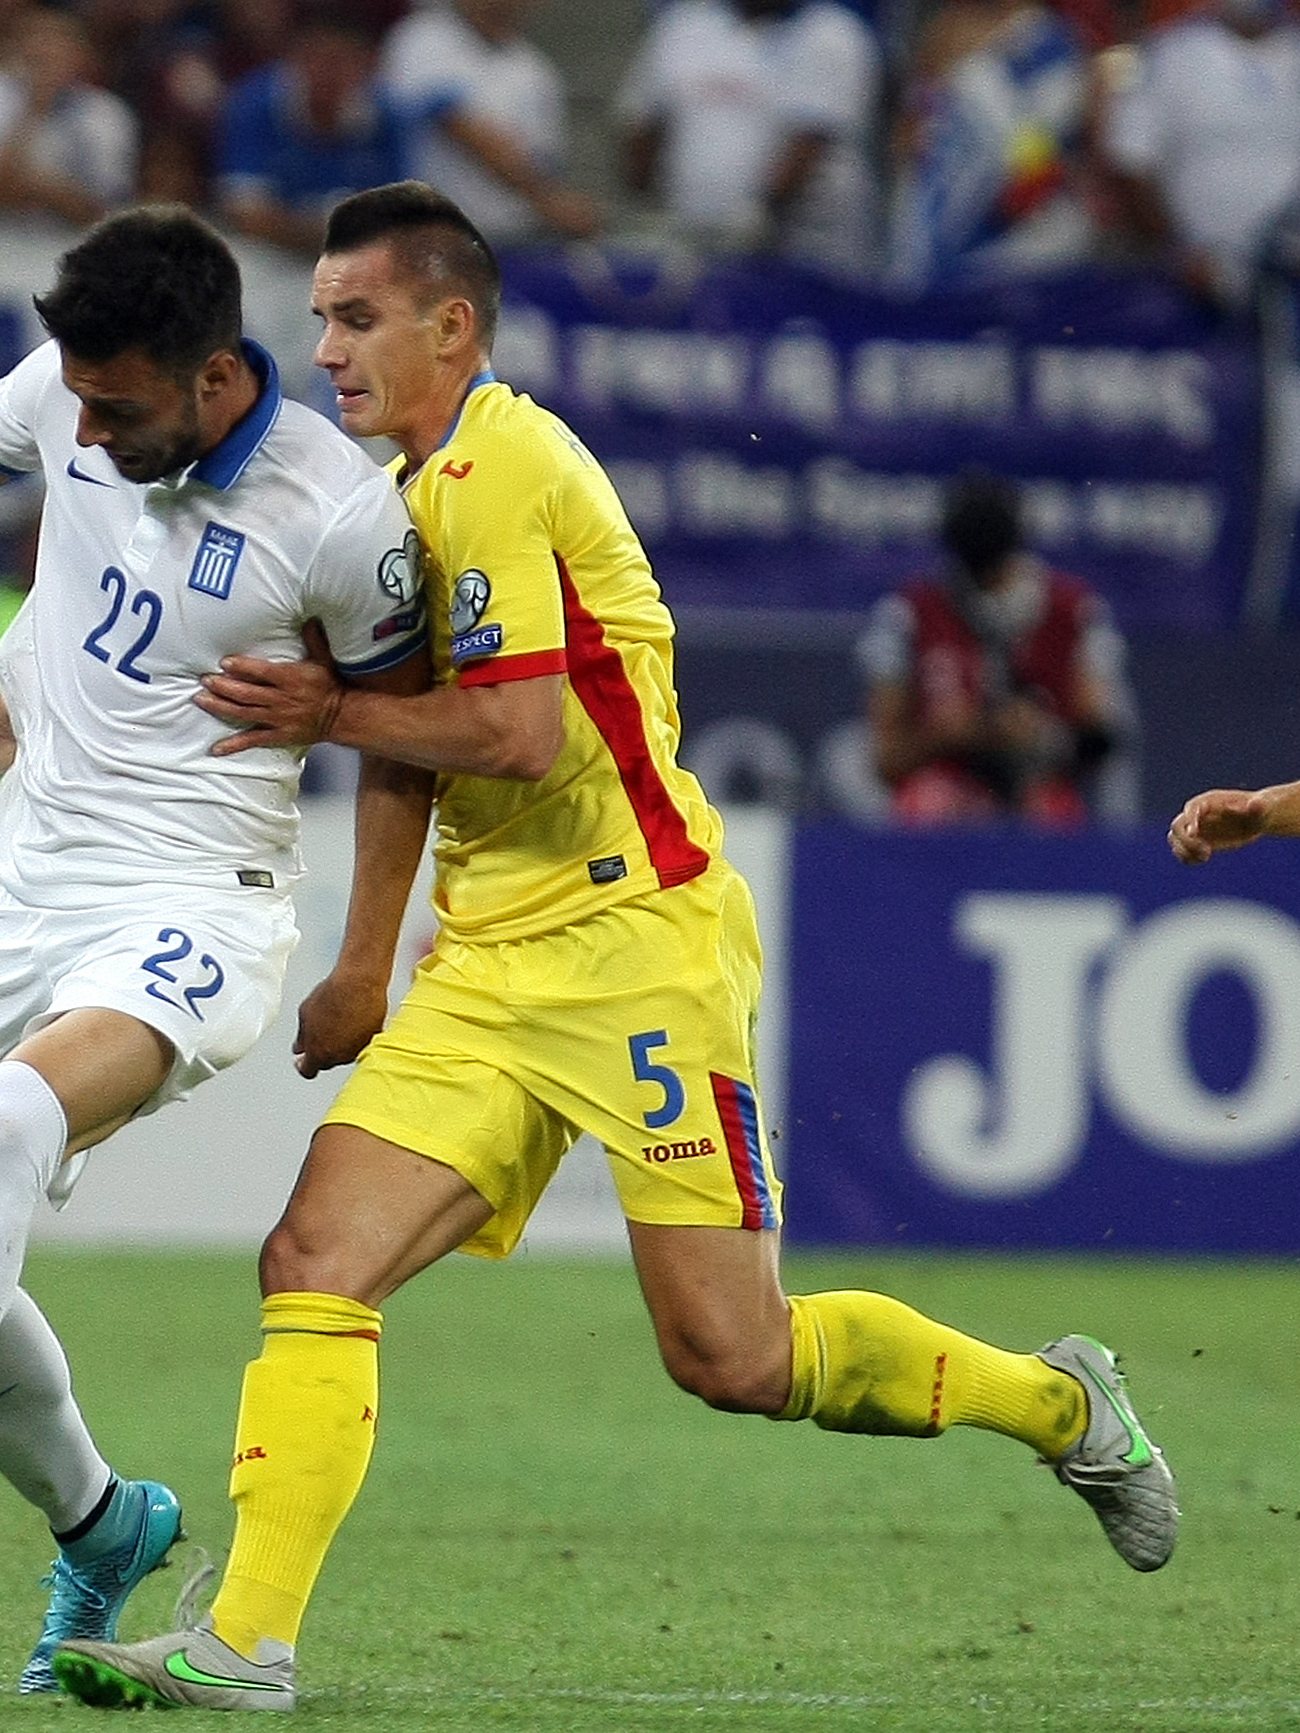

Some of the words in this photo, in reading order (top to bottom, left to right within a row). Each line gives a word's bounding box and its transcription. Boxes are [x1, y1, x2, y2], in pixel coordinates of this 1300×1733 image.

[83, 566, 162, 684] 22
[141, 927, 225, 1022] 22
[628, 1029, 686, 1129] 5
